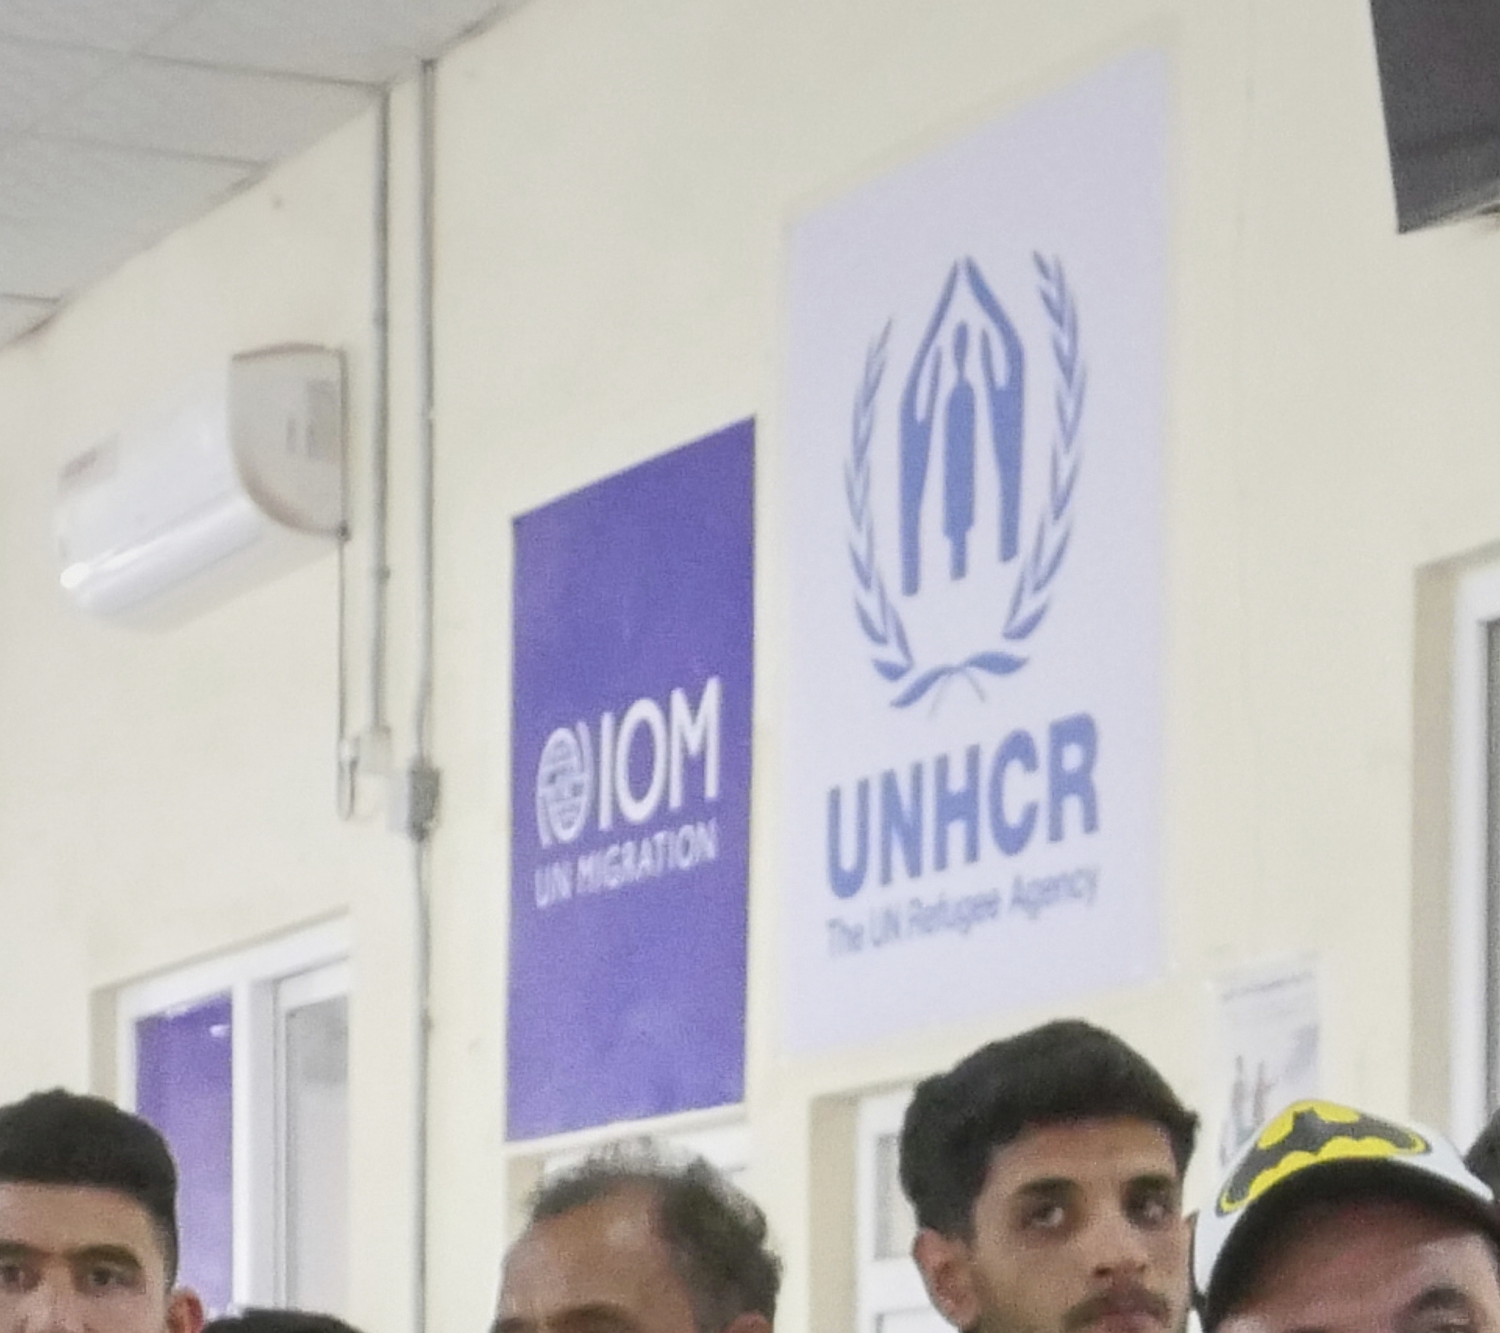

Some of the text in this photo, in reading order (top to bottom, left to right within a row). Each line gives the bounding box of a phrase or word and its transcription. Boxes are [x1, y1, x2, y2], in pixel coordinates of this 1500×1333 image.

[599, 675, 722, 831] IOM
[826, 711, 1099, 899] UNHCR
[535, 817, 719, 909] UN MIGRATION
[826, 865, 1100, 956] The UN Refugee Agency
